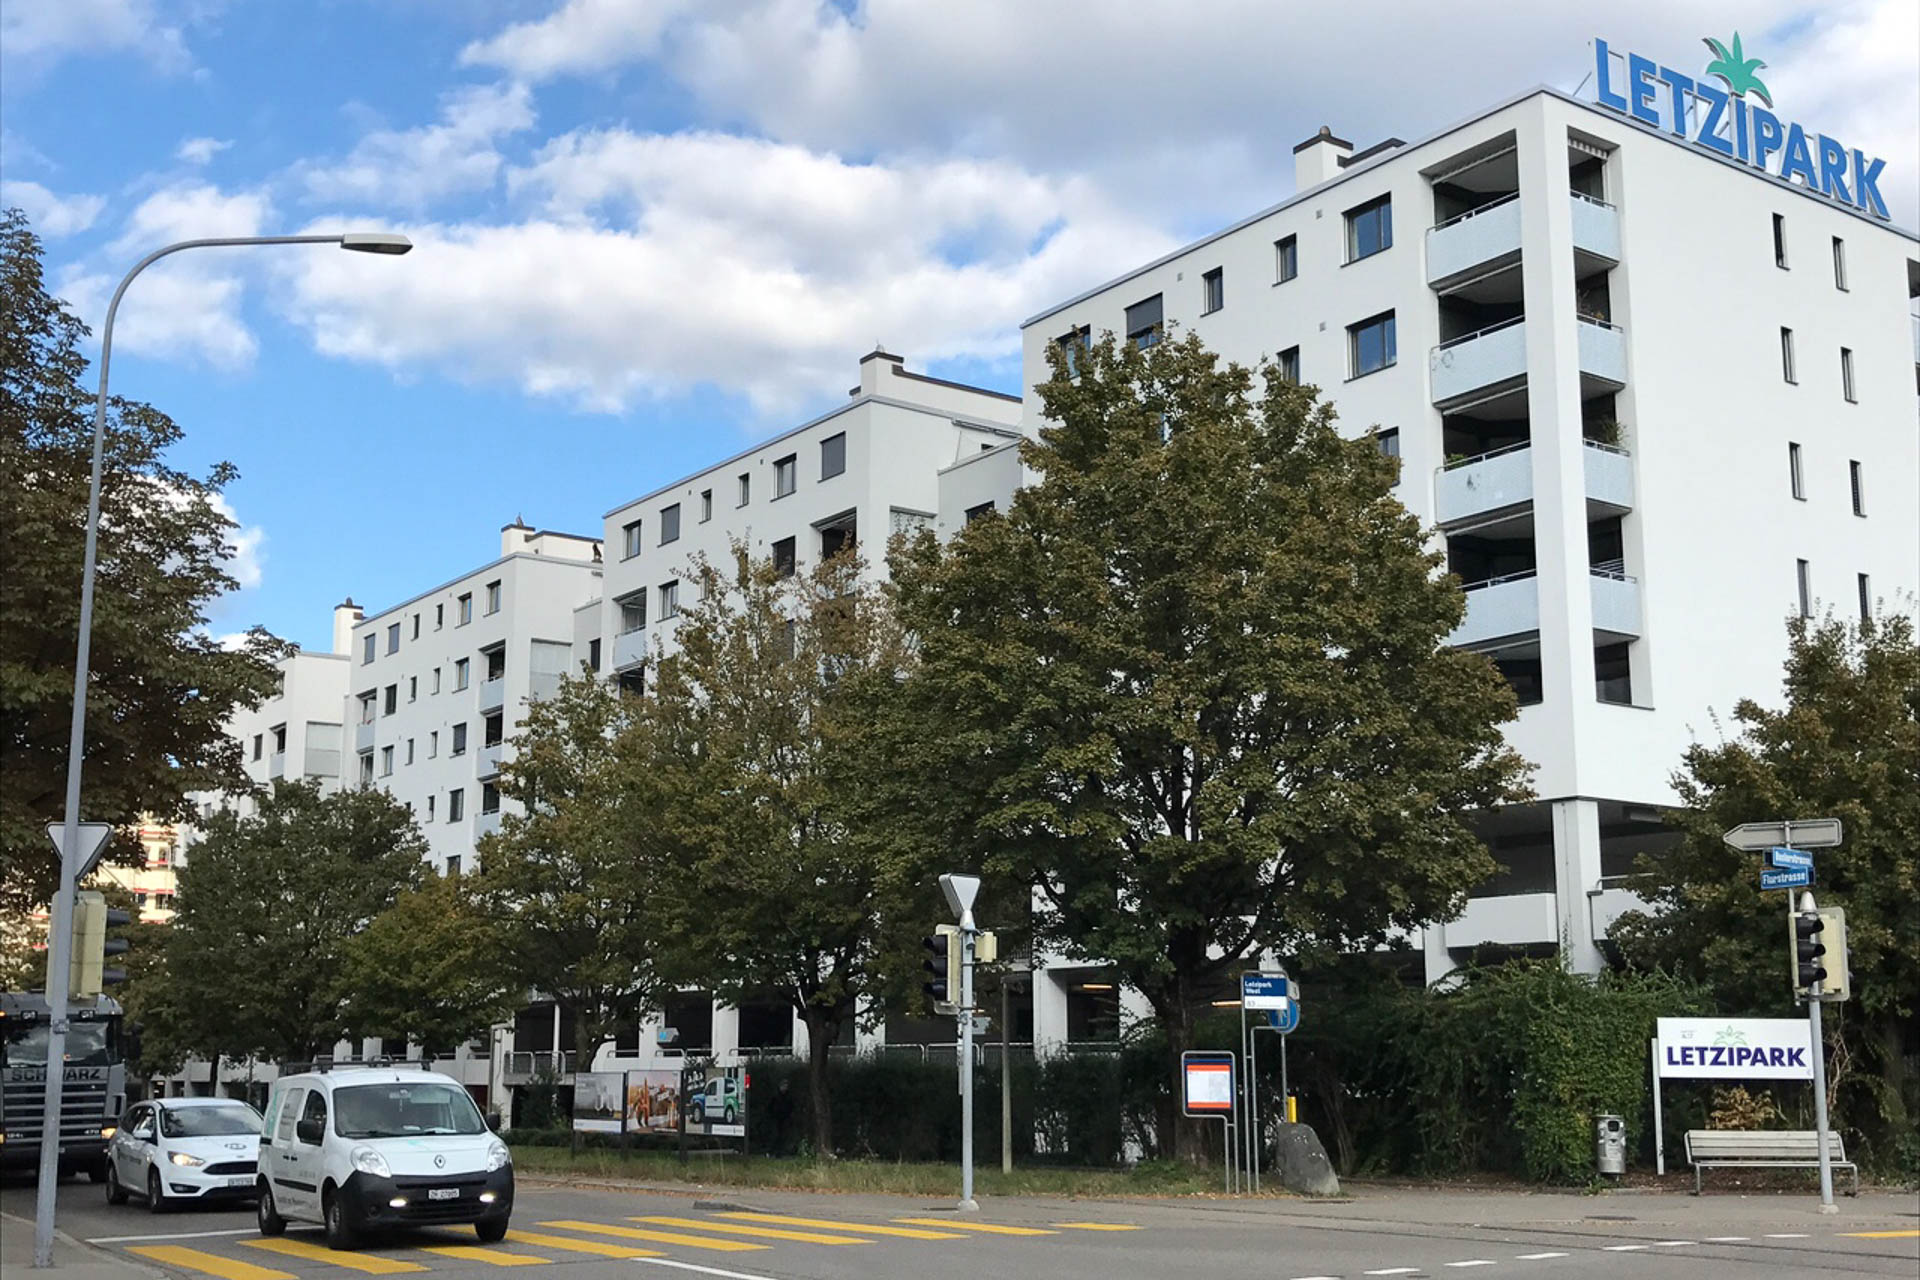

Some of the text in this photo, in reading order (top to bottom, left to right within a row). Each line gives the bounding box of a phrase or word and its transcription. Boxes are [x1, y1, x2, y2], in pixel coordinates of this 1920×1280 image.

[1594, 37, 1891, 221] LETZIPARK
[1763, 872, 1806, 885] Flurstrasse
[1666, 1045, 1807, 1067] LETZIPARK
[12, 1068, 100, 1080] SCHARZ
